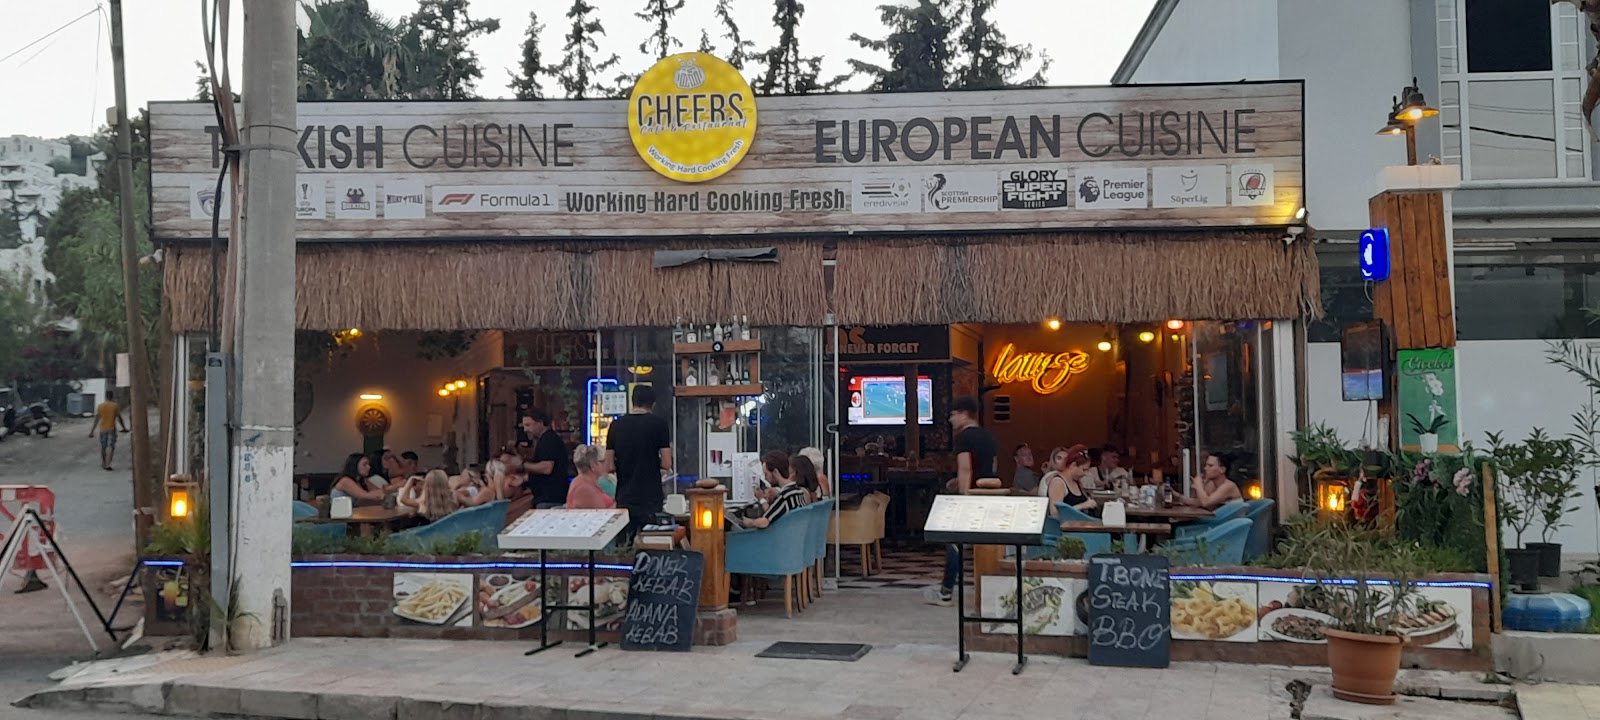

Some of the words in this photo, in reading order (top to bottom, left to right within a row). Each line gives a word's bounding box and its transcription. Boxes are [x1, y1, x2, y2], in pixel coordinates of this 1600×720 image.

[638, 92, 744, 128] CHEERS
[682, 118, 747, 132] Restaurant
[814, 114, 1061, 163] EUROPEAN
[1076, 109, 1256, 159] CUISINE
[204, 124, 383, 169] TKISH
[403, 122, 575, 168] CUISINE
[648, 146, 676, 172] Working
[677, 165, 696, 174] Hard
[697, 157, 728, 174] Cooking
[726, 139, 743, 160] Fresh
[1003, 181, 1066, 192] SUPER
[1010, 169, 1059, 182] GLORY
[1103, 179, 1145, 190] Premier
[566, 192, 647, 214] Working
[654, 190, 700, 212] Hard
[706, 189, 783, 212] Cooking
[789, 187, 845, 210] Fresh
[941, 195, 998, 204] PREMIERSHIP
[1007, 190, 1063, 202] FIGHT
[1103, 189, 1145, 202] League
[877, 342, 920, 354] FORGET
[625, 598, 679, 626] ADANA
[1090, 584, 1161, 619] STEAK
[625, 623, 679, 645] KEBAB
[1092, 615, 1170, 650] BBQ
